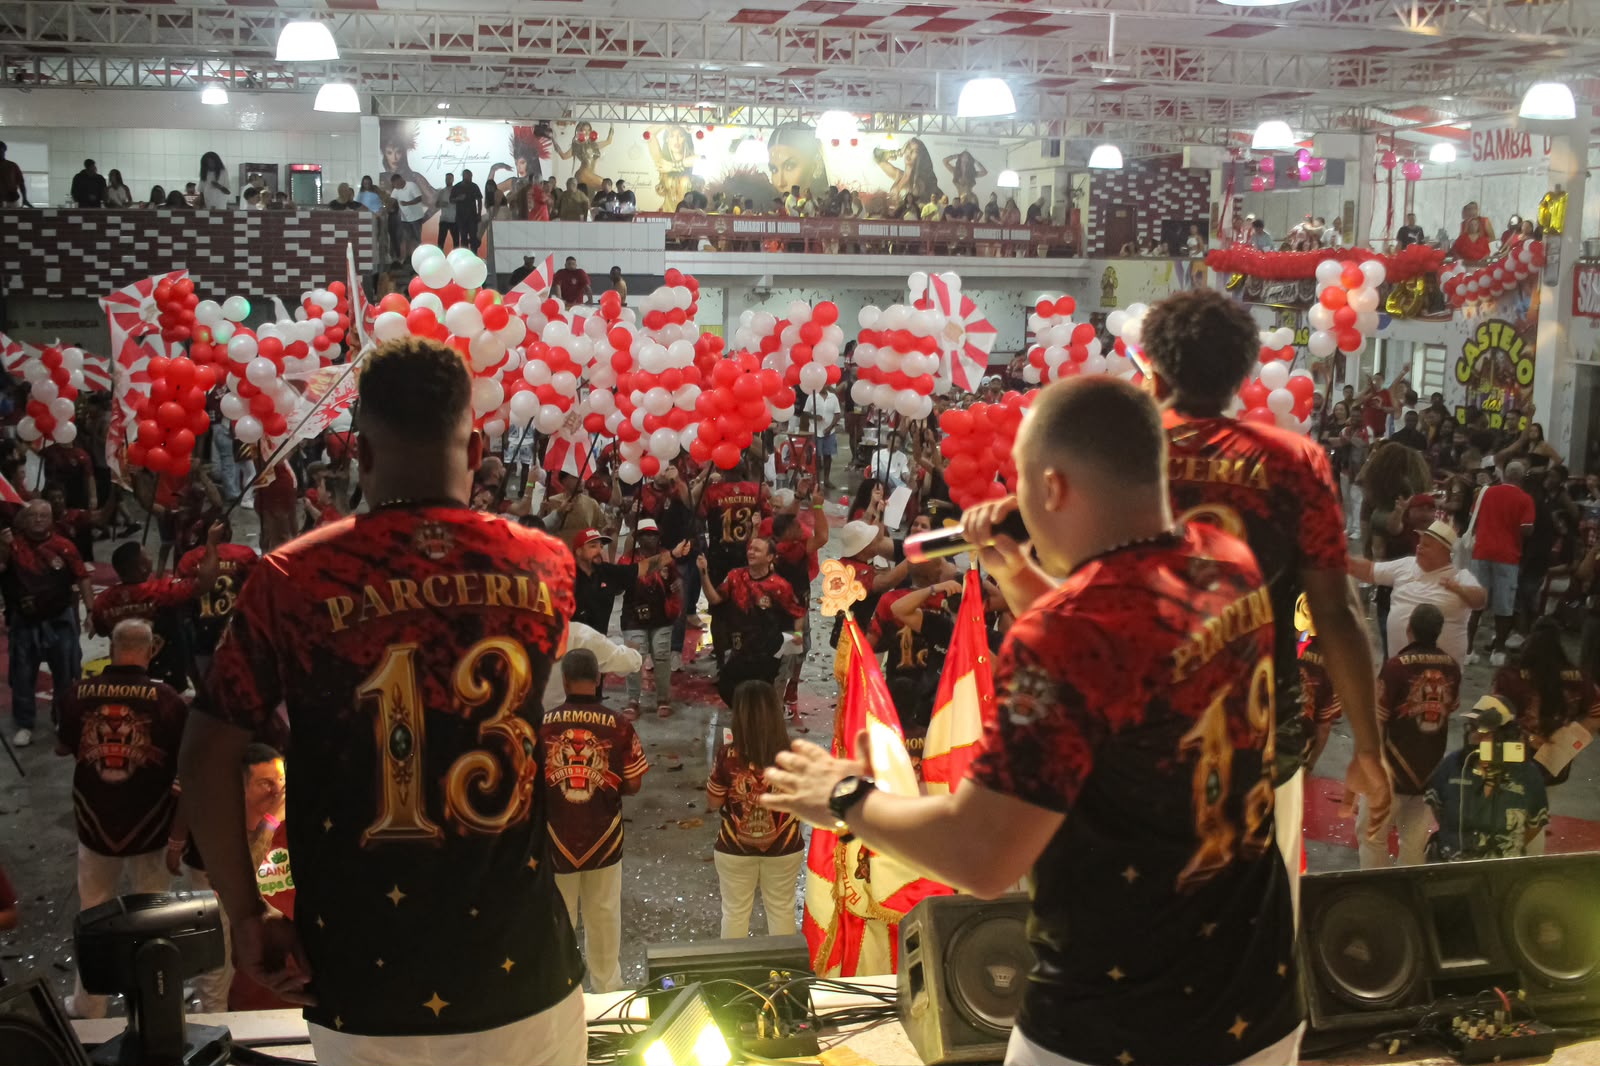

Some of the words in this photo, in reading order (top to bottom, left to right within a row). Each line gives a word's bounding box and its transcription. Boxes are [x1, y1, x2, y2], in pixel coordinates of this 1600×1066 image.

[1472, 128, 1532, 161] SAMBA
[1455, 320, 1534, 386] CASTELO
[720, 506, 752, 543] 13
[324, 572, 555, 633] PARCERIA
[1171, 585, 1274, 684] PARCERI
[77, 684, 158, 700] HARMONIA
[543, 710, 617, 728] HARMONIA
[355, 635, 538, 846] 13
[550, 767, 574, 782] PORTO
[583, 768, 606, 786] PEDRA
